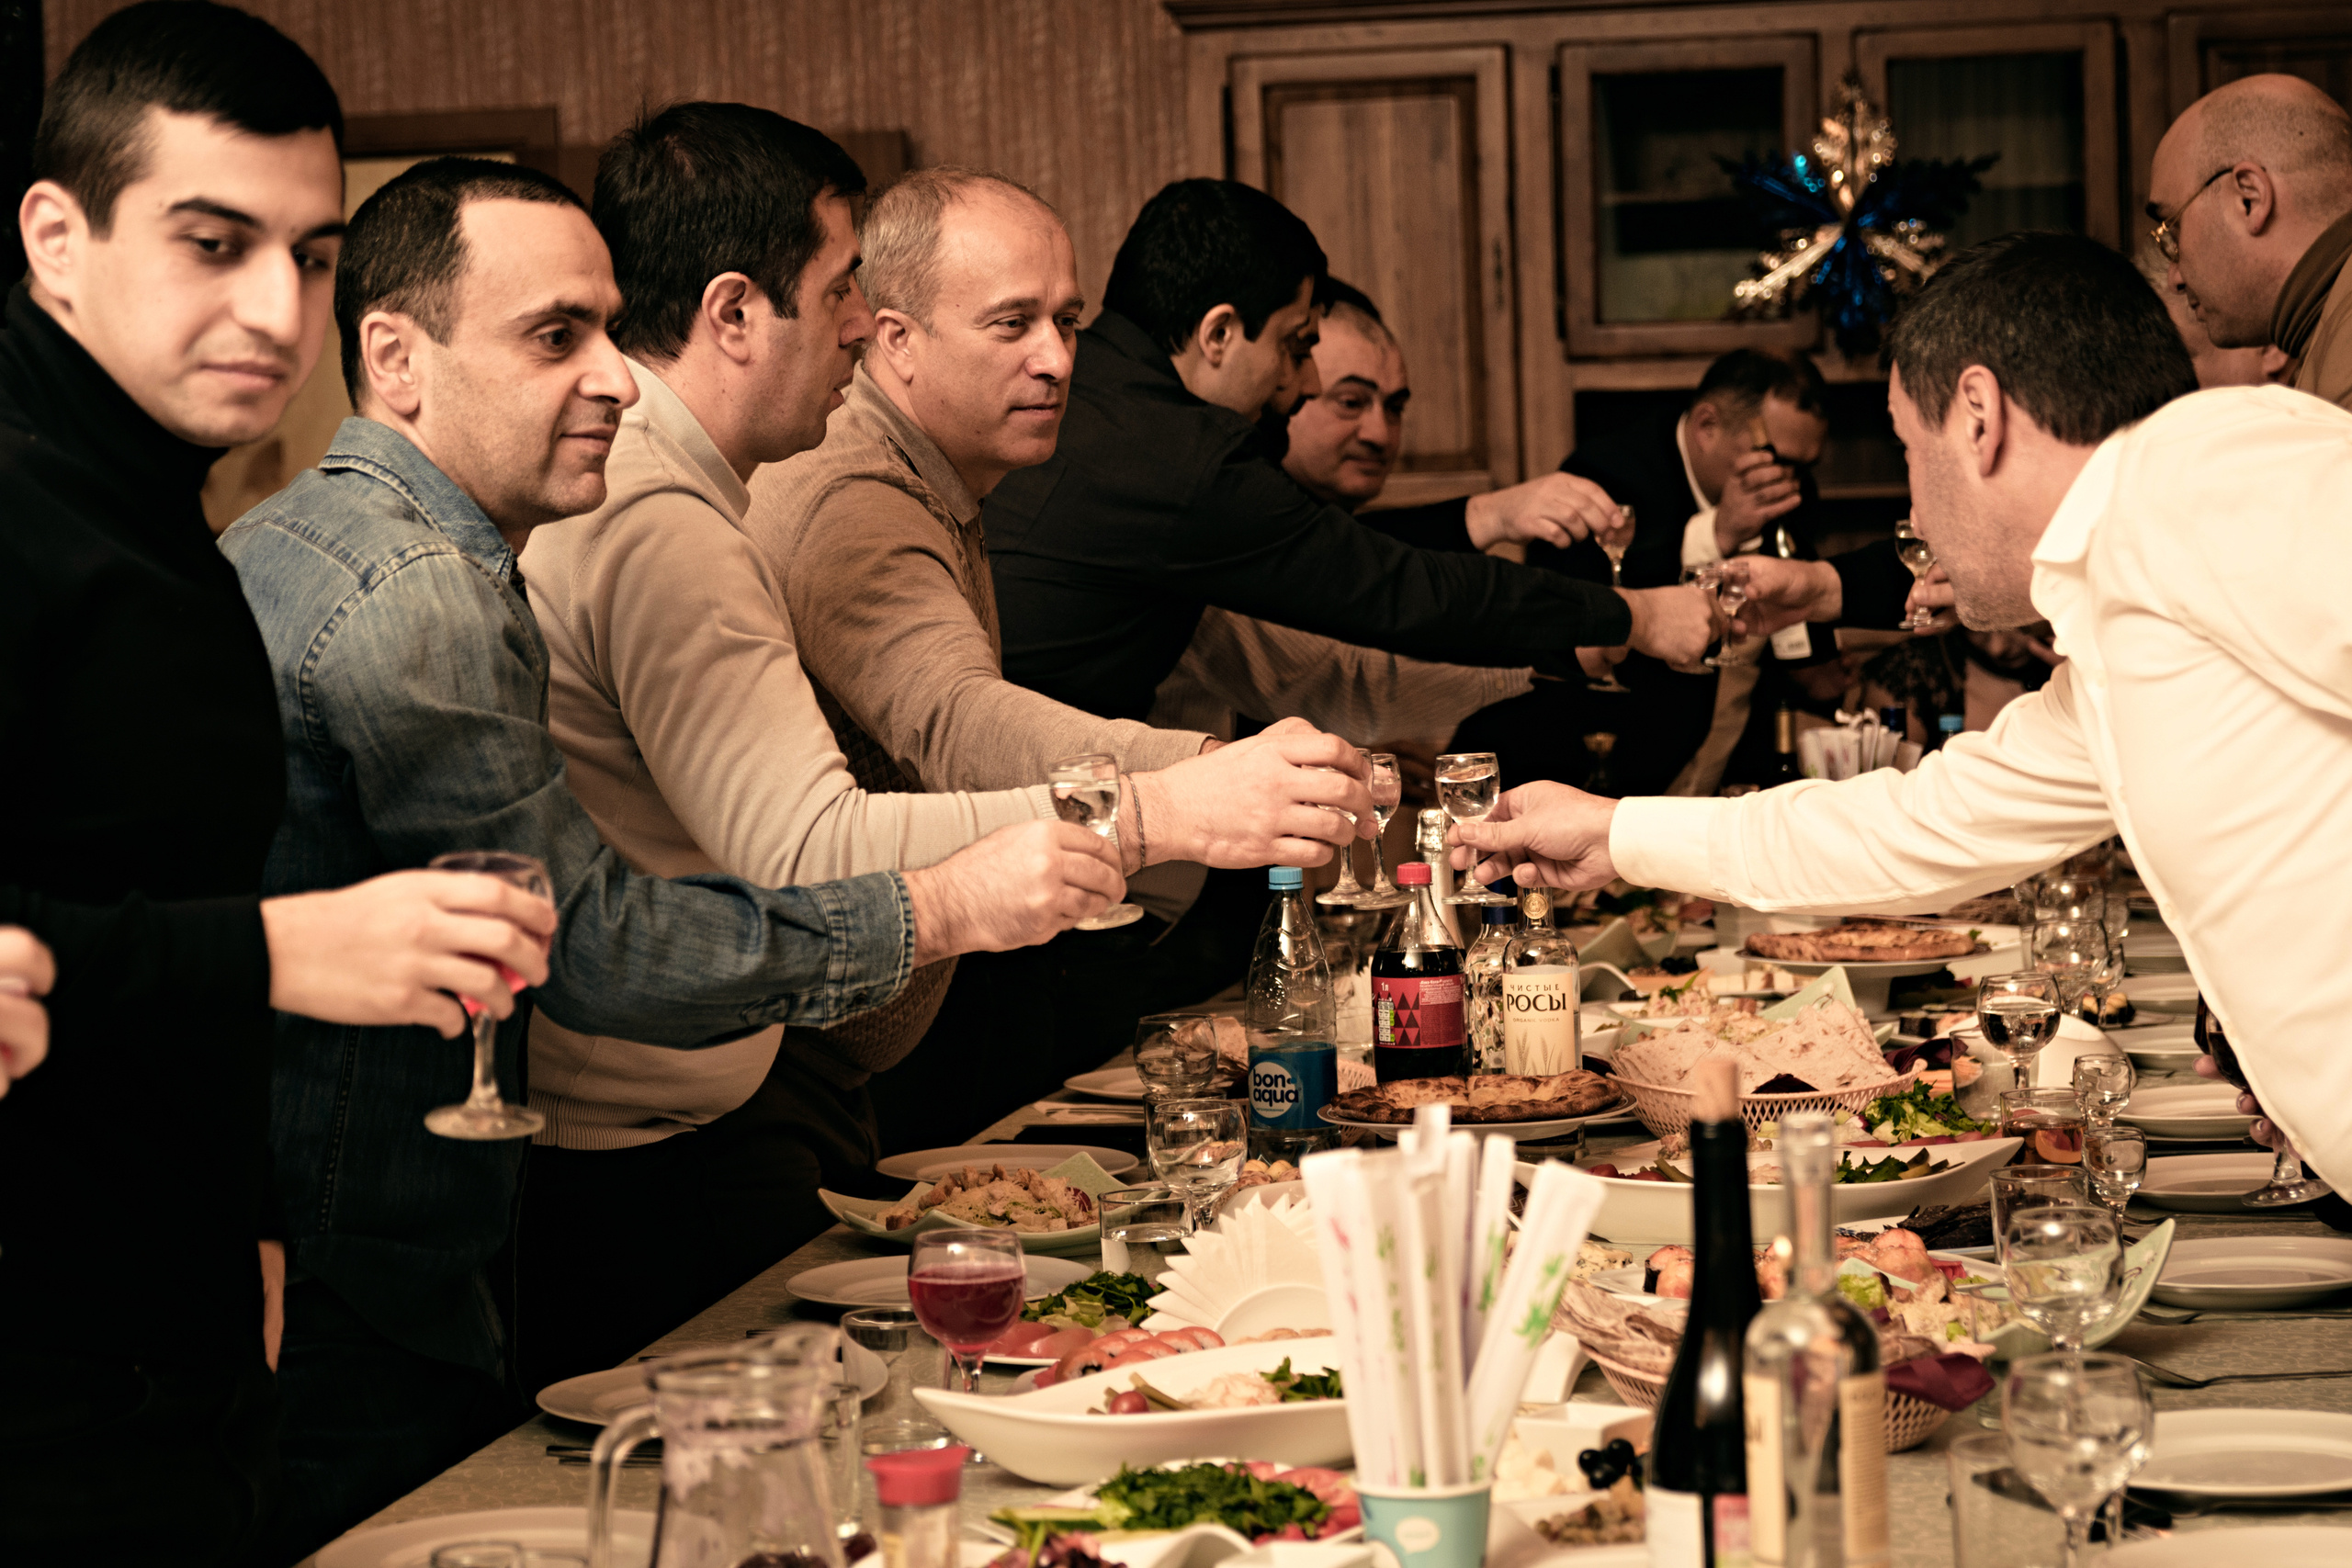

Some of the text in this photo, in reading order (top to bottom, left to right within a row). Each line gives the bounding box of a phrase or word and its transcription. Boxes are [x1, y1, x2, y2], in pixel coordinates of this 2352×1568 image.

[1381, 982, 1389, 991] 1л
[1510, 984, 1560, 992] ЧИСТЫЕ
[1506, 993, 1567, 1012] РОСЫ
[1253, 1068, 1286, 1088] bon
[1253, 1089, 1299, 1108] aqua
